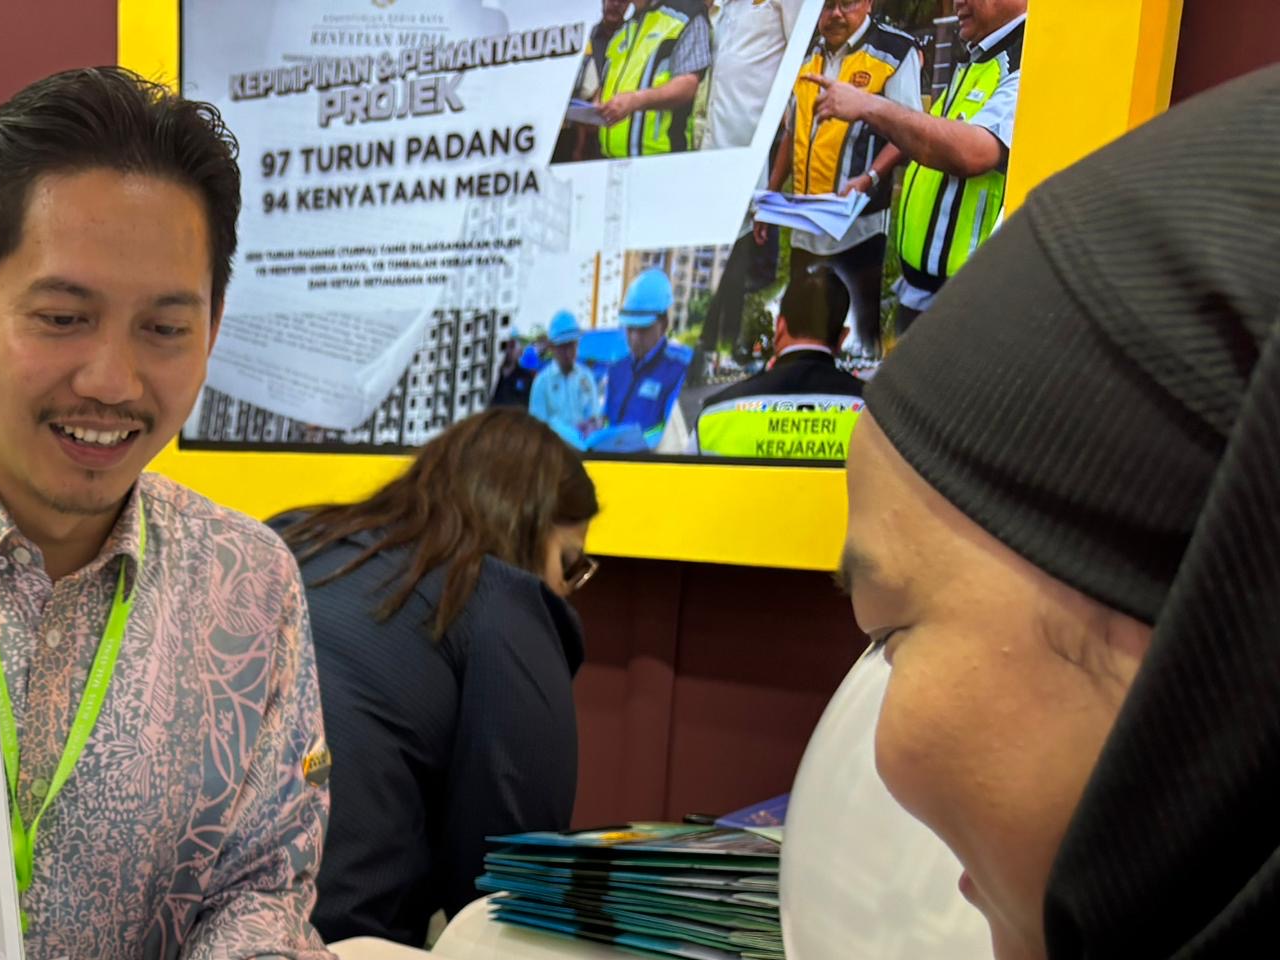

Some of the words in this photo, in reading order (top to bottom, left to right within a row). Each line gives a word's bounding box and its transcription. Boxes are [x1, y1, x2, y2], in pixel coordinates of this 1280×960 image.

[228, 55, 373, 102] KEPIMPINAN
[375, 51, 398, 82] &
[398, 21, 586, 80] PEMANTAUAN
[319, 74, 464, 127] PROJEK
[261, 149, 291, 177] 97
[300, 139, 396, 174] TURUN
[405, 125, 536, 165] PADANG
[262, 190, 289, 214] 94
[296, 177, 447, 212] KENYATAAN
[454, 169, 540, 199] MEDIA
[755, 440, 845, 458] KERJARAYA
[767, 418, 837, 434] MENTERI
